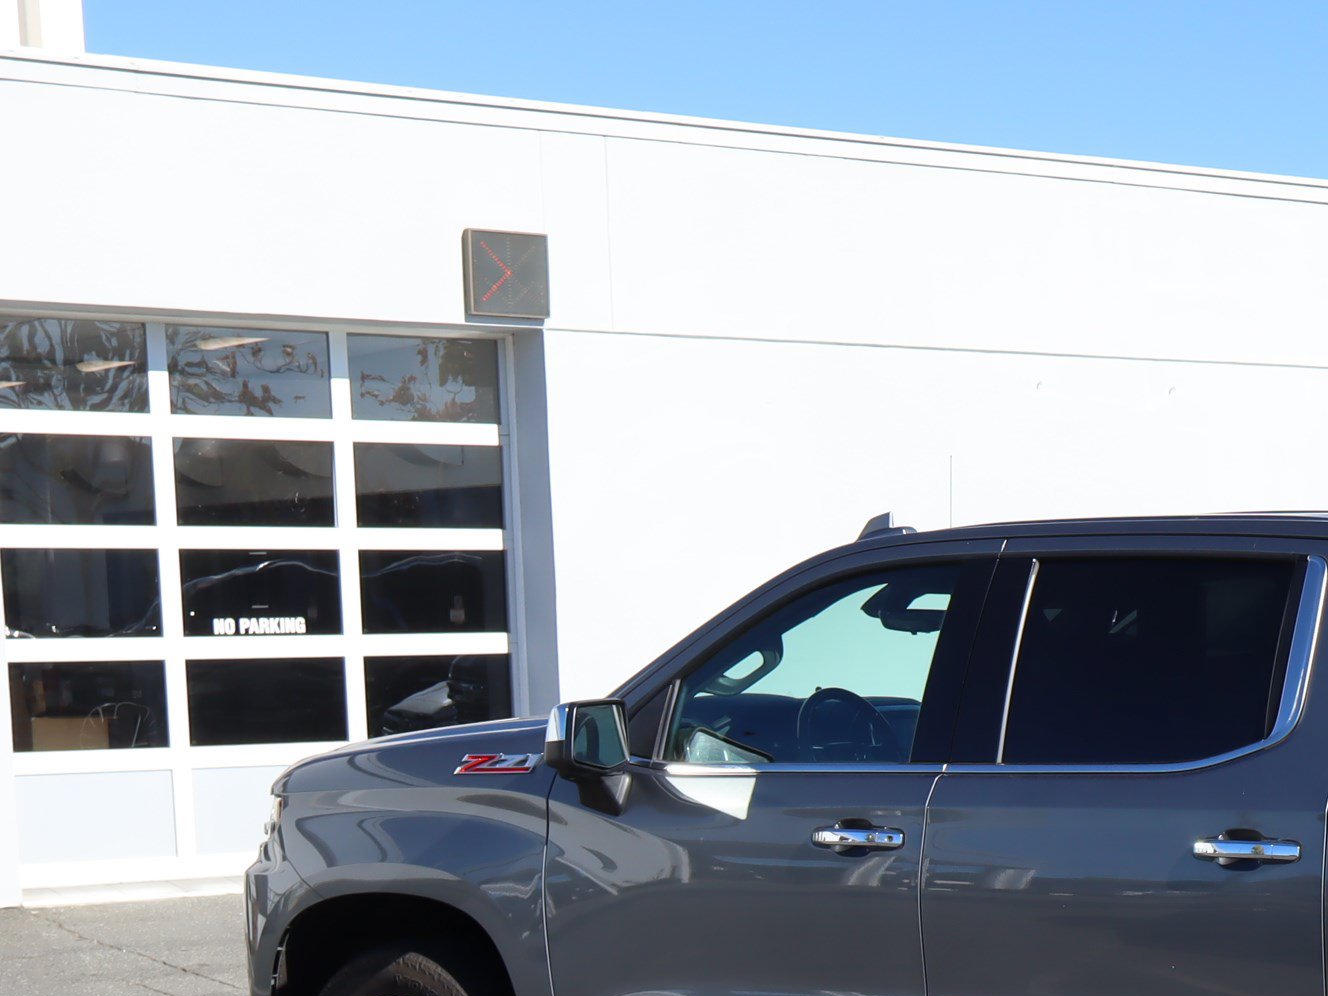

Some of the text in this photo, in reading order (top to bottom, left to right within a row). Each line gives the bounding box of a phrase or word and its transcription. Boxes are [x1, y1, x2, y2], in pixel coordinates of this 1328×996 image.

[213, 617, 306, 635] NO PARKING
[453, 752, 544, 775] Z71
